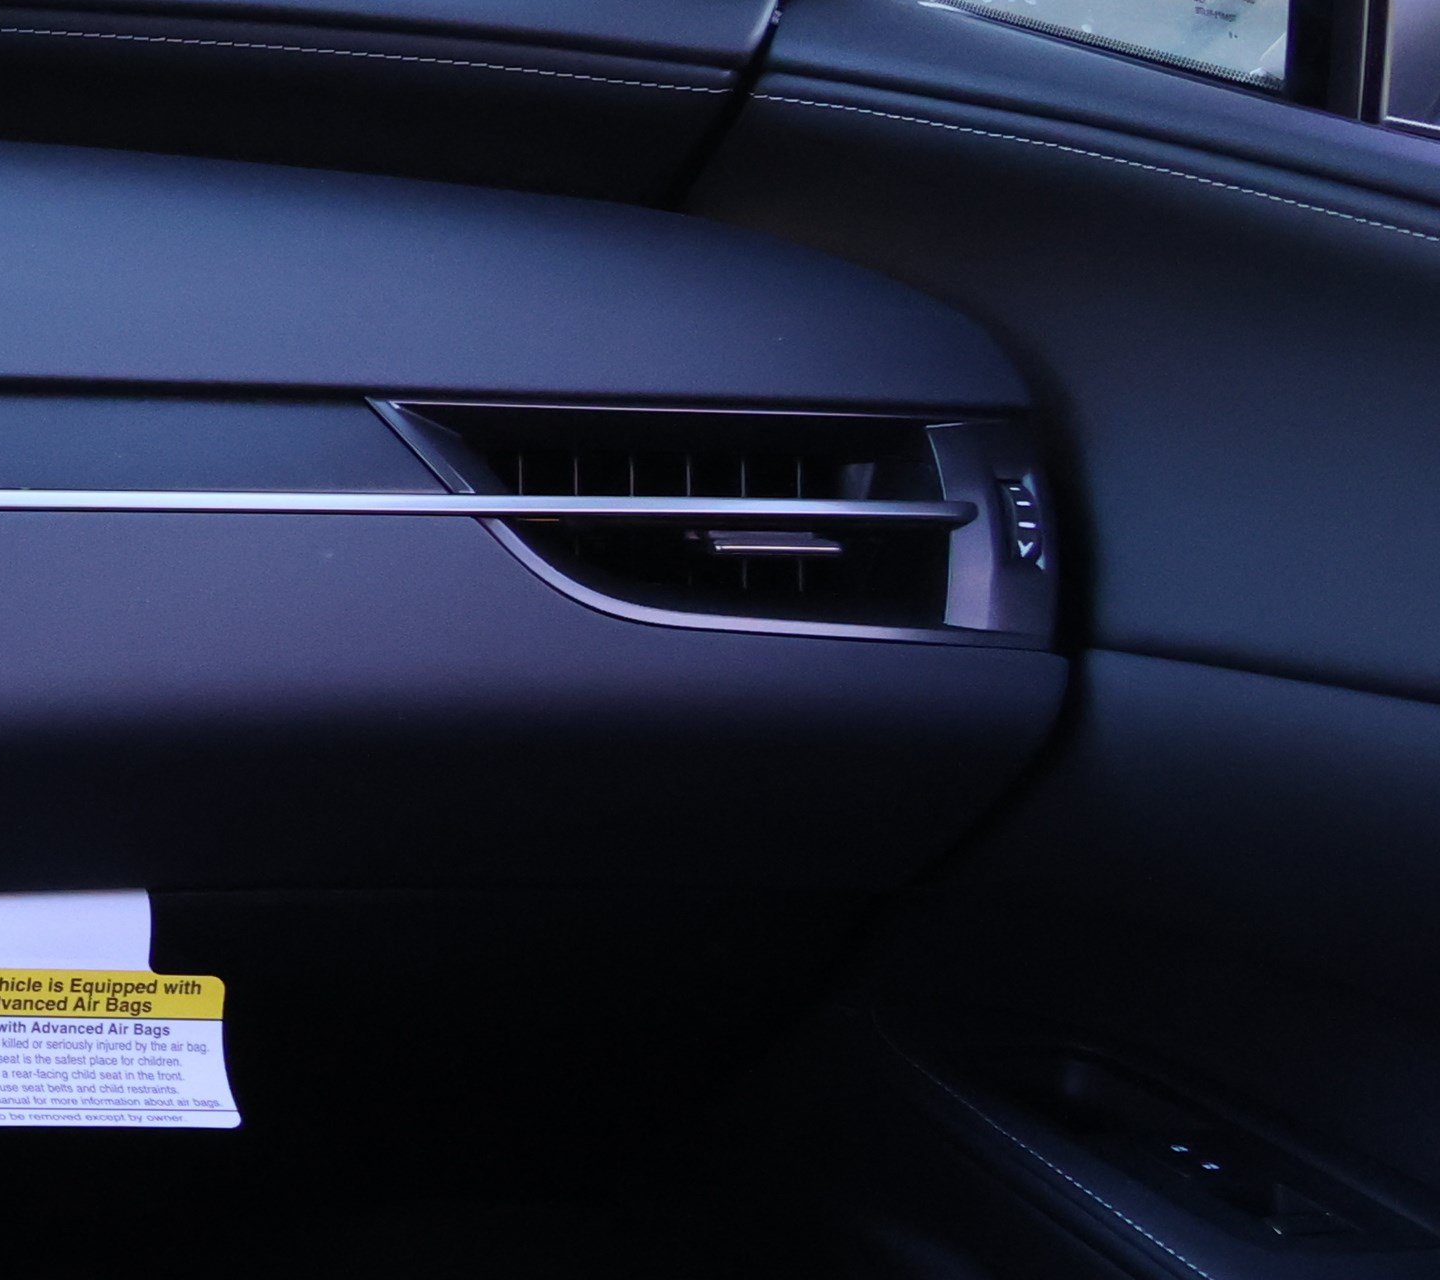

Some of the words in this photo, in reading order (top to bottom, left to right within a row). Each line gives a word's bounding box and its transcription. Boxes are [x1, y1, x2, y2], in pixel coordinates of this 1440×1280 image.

[48, 977, 64, 993] is
[69, 978, 158, 997] Equipped
[164, 980, 202, 995] with
[73, 996, 100, 1012] Air
[105, 997, 153, 1017] Bags
[31, 1021, 104, 1035] Advanced
[107, 1023, 129, 1035] Air
[133, 1023, 171, 1039] Bags
[1, 1037, 29, 1049] killed
[32, 1040, 44, 1049] or
[46, 1039, 93, 1053] seriously
[96, 1039, 131, 1053] injured
[135, 1040, 148, 1053] by
[150, 1041, 167, 1052] the
[170, 1041, 184, 1052] air
[187, 1041, 210, 1055] bag.
[23, 1054, 32, 1065] is
[35, 1054, 52, 1065] the
[54, 1054, 86, 1066] safest
[89, 1055, 118, 1068] place
[120, 1056, 134, 1067] for
[137, 1056, 182, 1068] children.
[11, 1069, 69, 1082] rear-facing
[71, 1070, 96, 1081] child
[99, 1071, 122, 1081] seat
[125, 1070, 135, 1081] in
[137, 1070, 155, 1081] the
[157, 1071, 185, 1082] front.
[0, 1084, 19, 1093] use
[21, 1083, 45, 1093] seat
[47, 1083, 73, 1093] belts
[76, 1084, 96, 1094] and
[99, 1084, 125, 1094] child
[127, 1084, 180, 1095] restraints.
[33, 1095, 48, 1105] for
[51, 1097, 78, 1106] more
[81, 1096, 141, 1107] information
[144, 1097, 174, 1107] about
[192, 1098, 223, 1109] bags.
[28, 1112, 81, 1122] removed
[85, 1113, 125, 1123] except
